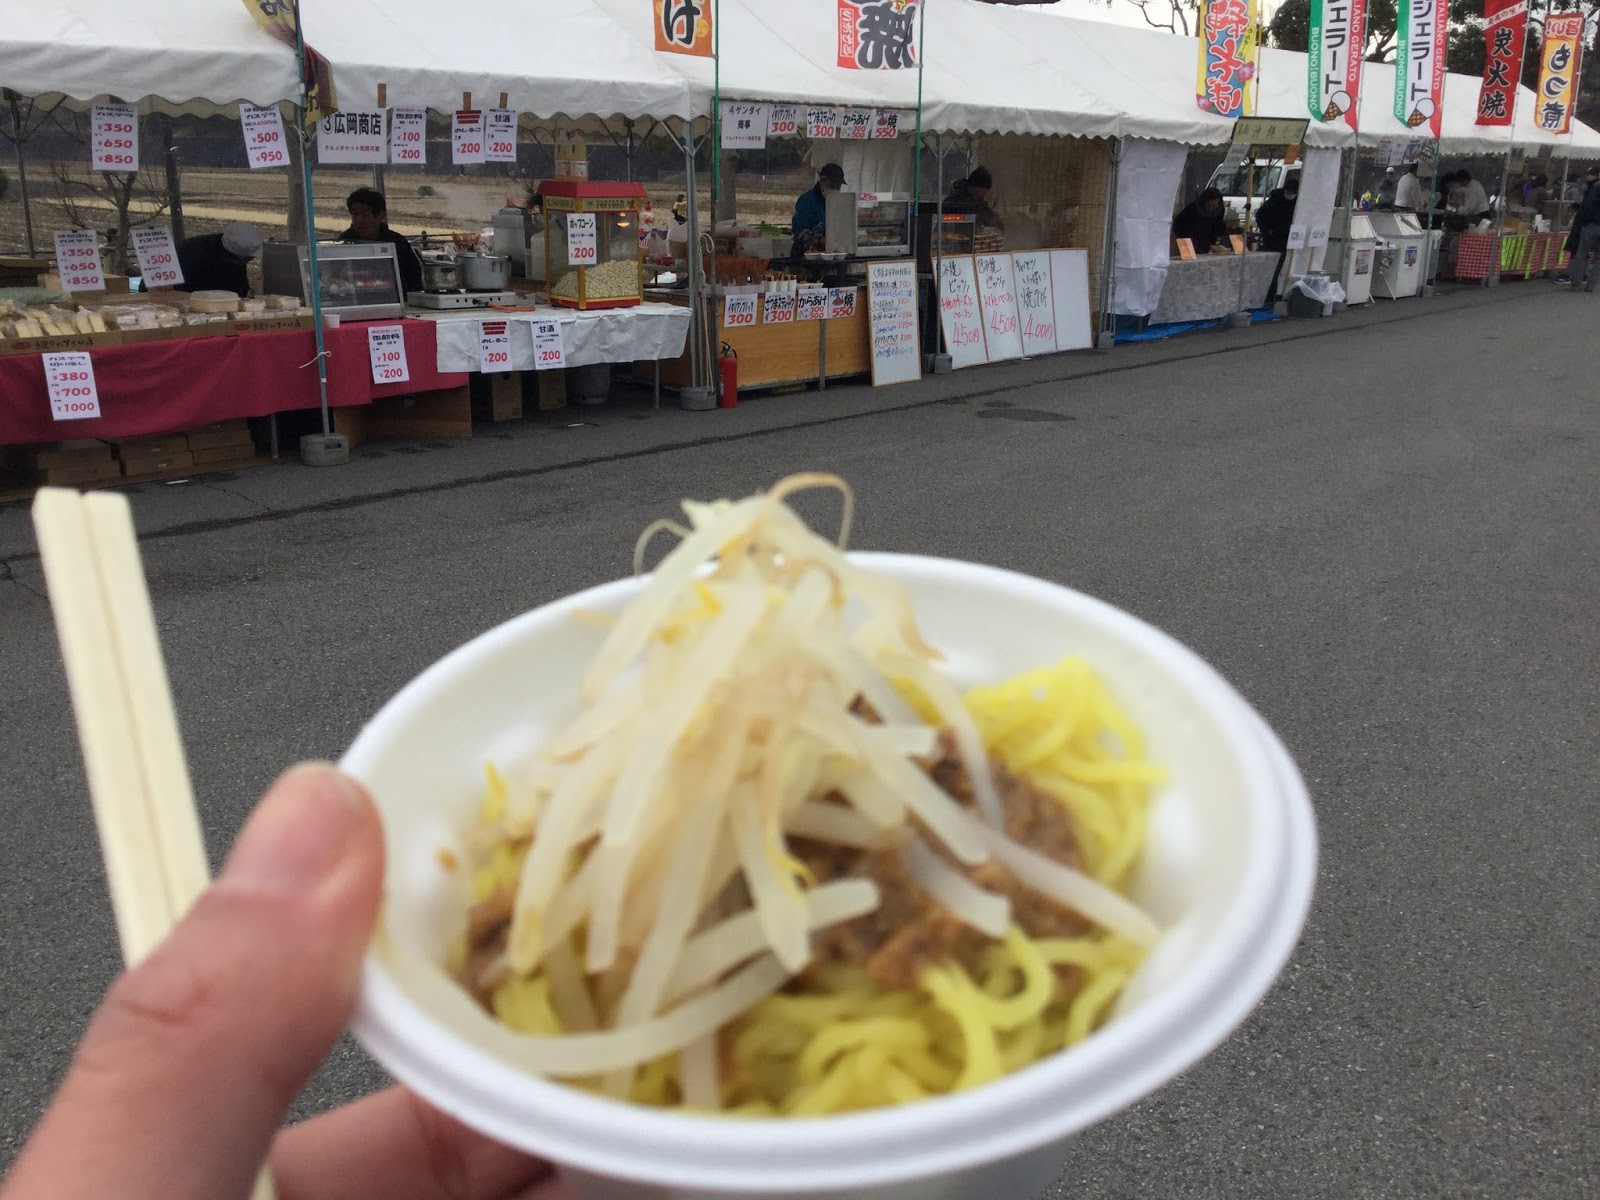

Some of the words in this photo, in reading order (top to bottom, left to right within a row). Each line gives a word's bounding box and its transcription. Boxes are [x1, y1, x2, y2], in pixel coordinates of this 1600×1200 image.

[1325, 0, 1347, 94] ェラート
[1349, 35, 1360, 82] GERATO
[1433, 48, 1443, 90] GERATO
[1480, 28, 1513, 118] 炭火焼
[494, 114, 510, 122] 甘酒
[843, 114, 870, 126] からあげ
[887, 114, 898, 128] 焼
[98, 123, 132, 132] ¥350
[771, 121, 795, 133] 300
[814, 125, 834, 136] 300
[252, 132, 278, 143] ¥500
[397, 132, 420, 141] ¥100
[876, 128, 896, 137] 550
[98, 138, 133, 148] ¥650
[489, 142, 512, 152] ¥200
[457, 143, 480, 154] ¥200
[98, 154, 133, 164] ¥850
[256, 151, 282, 162] ¥950
[397, 150, 420, 159] ¥200
[62, 248, 94, 256] ¥350
[146, 254, 171, 264] ¥500
[64, 262, 96, 271] ¥650
[941, 260, 961, 277] み焼
[67, 276, 98, 284] ¥850
[151, 270, 176, 281] ¥950
[798, 296, 827, 308] からあげ
[844, 294, 854, 306] 焼
[770, 310, 792, 322] 300
[832, 306, 853, 317] 550
[728, 313, 753, 324] 300
[539, 325, 555, 333] 甘酒
[377, 352, 400, 361] ¥100
[484, 352, 507, 362] ¥200
[539, 350, 560, 360] ¥200
[53, 372, 88, 381] ¥380
[380, 369, 402, 378] ¥200
[55, 388, 91, 396] ¥700
[57, 402, 94, 412] ¥1000
